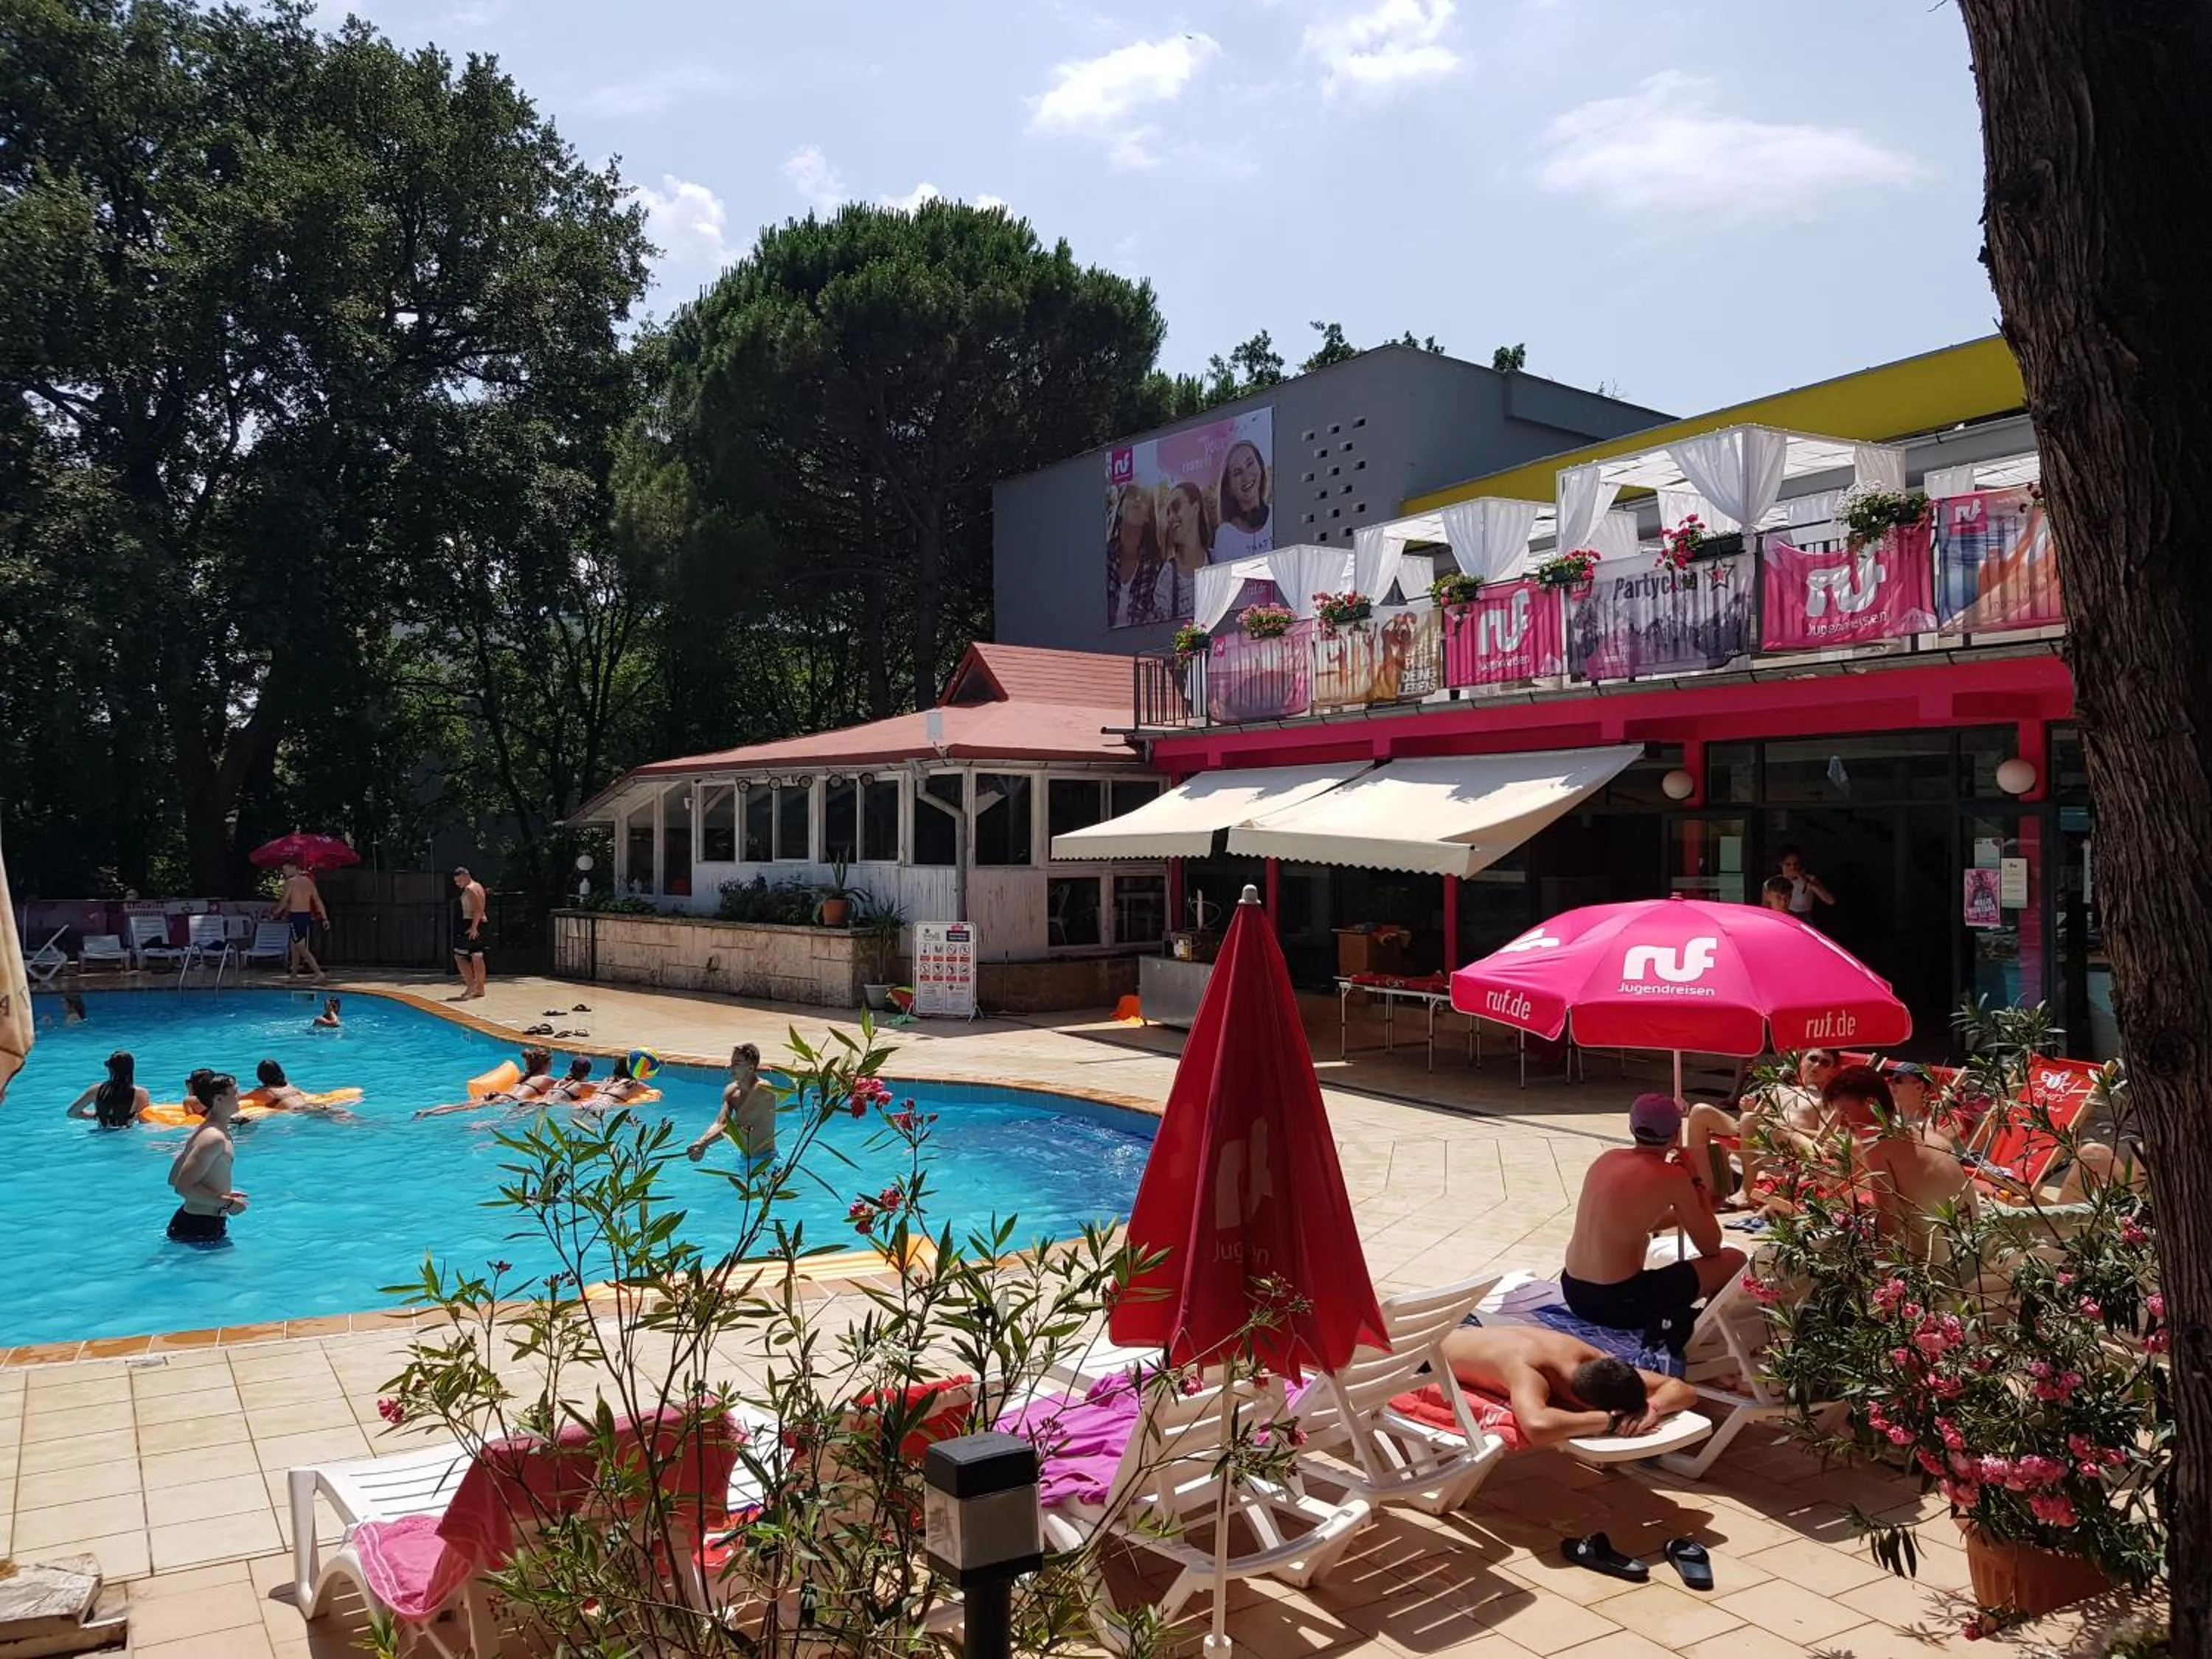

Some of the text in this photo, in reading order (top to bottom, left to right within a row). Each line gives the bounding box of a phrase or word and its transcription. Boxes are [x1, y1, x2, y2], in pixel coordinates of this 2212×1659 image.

[1478, 588, 1530, 655] ruf
[1623, 937, 1717, 982] ruf
[1486, 989, 1531, 1020] ruf.de
[1618, 982, 1715, 996] Jugendreisen
[1806, 1009, 1857, 1039] ruf.de
